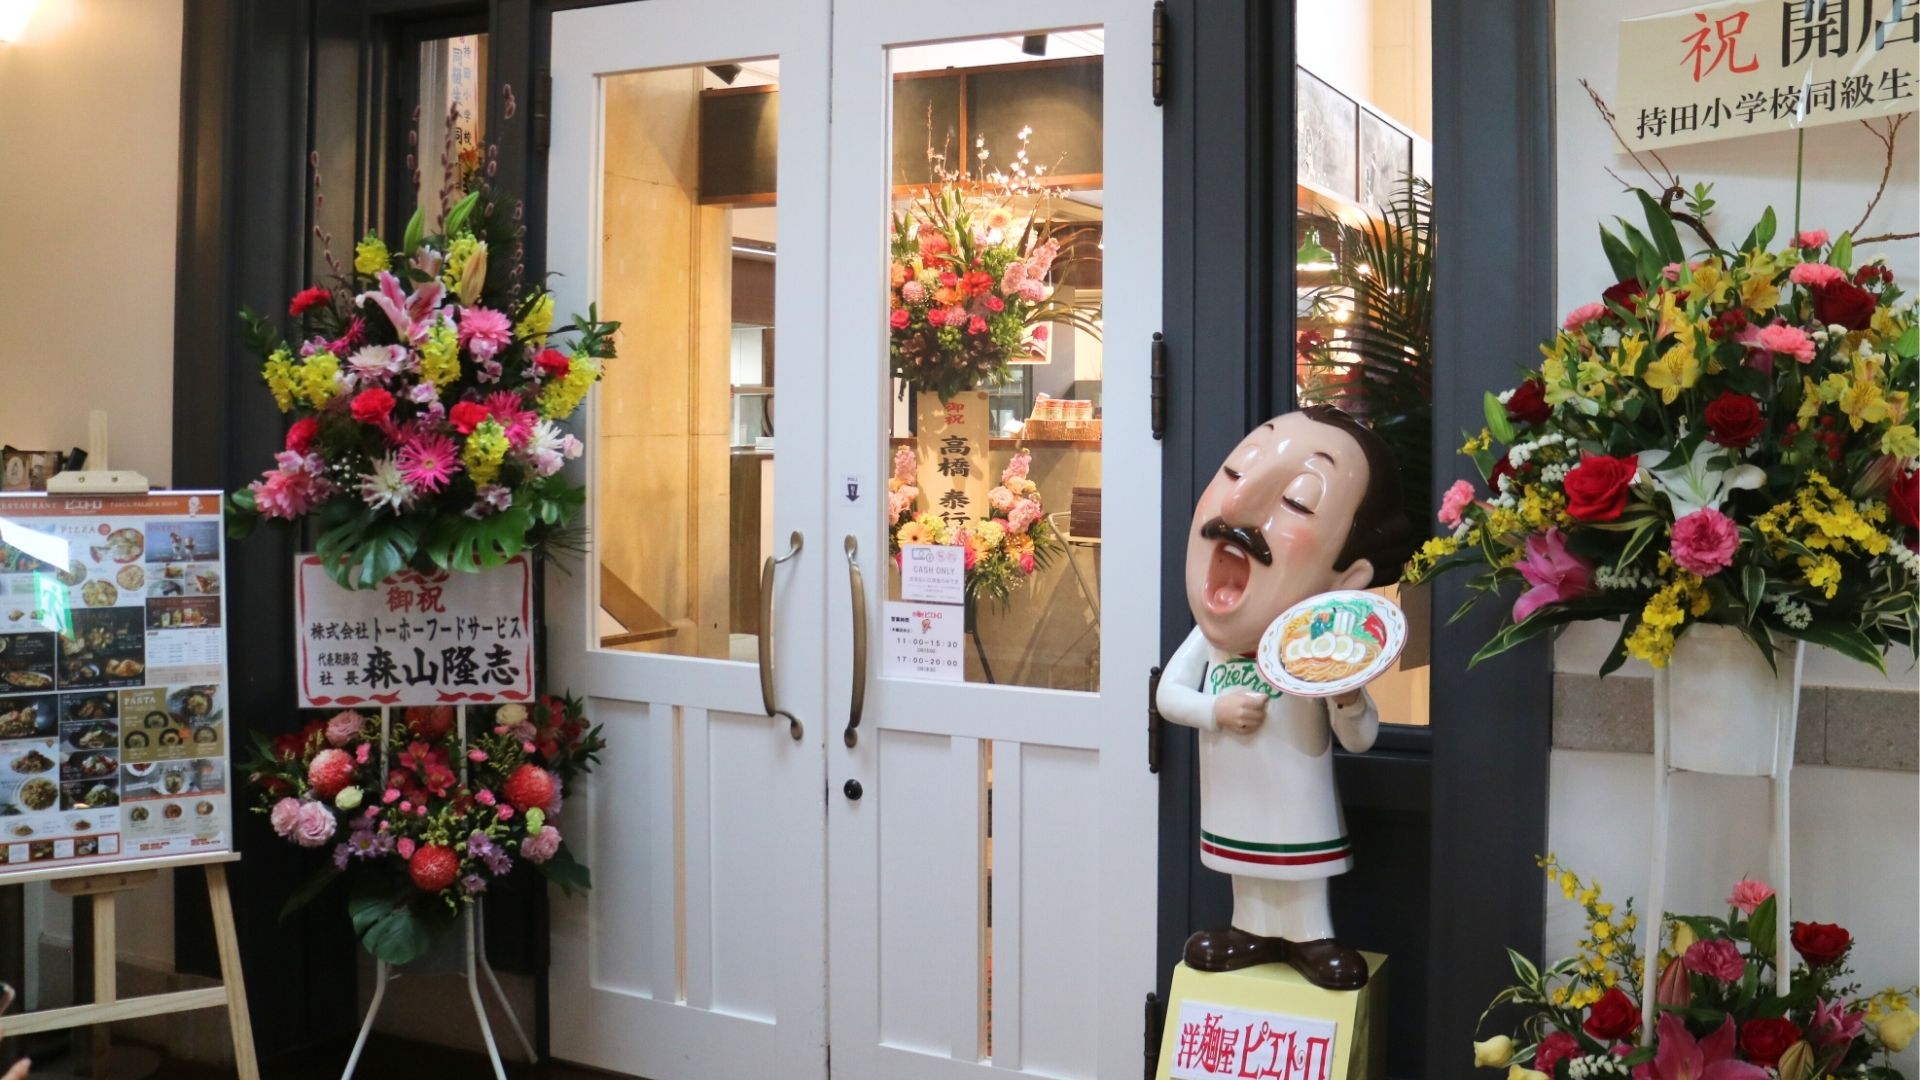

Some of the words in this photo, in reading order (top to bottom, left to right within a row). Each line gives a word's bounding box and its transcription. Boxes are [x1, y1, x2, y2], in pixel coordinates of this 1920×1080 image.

[1680, 11, 1759, 82] 祝
[1781, 0, 1919, 67] 開店
[1636, 67, 1919, 140] 持田小学校同級生
[944, 401, 965, 424] 御祝
[937, 434, 971, 477] 高橋
[61, 526, 96, 534] PIZZA
[913, 566, 934, 574] CASH
[936, 567, 955, 575] ONLY
[385, 586, 446, 613] 御祝
[361, 643, 520, 689] 森山隆志
[1211, 664, 1283, 699] Pietro
[124, 696, 157, 705] PASTA
